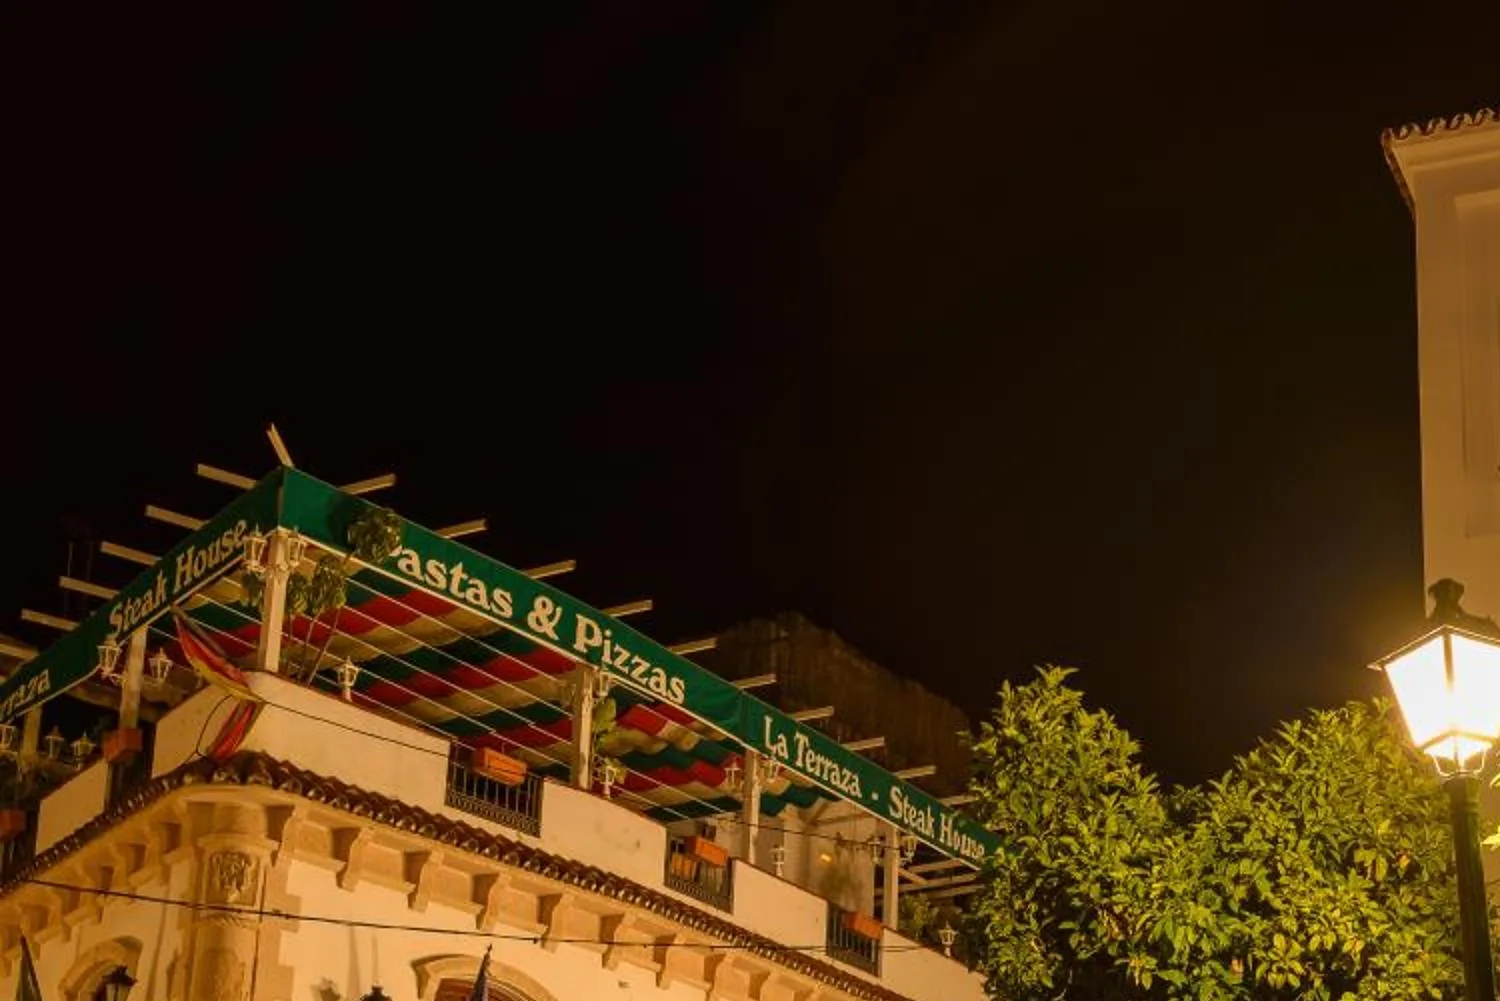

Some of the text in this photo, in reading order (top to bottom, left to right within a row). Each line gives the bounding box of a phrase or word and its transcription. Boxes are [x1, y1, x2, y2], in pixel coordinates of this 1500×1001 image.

[389, 544, 685, 704] astas & Pizzas
[764, 716, 789, 760] La
[794, 731, 863, 799] Terraza
[889, 785, 935, 838] Steak
[940, 812, 985, 860] House
